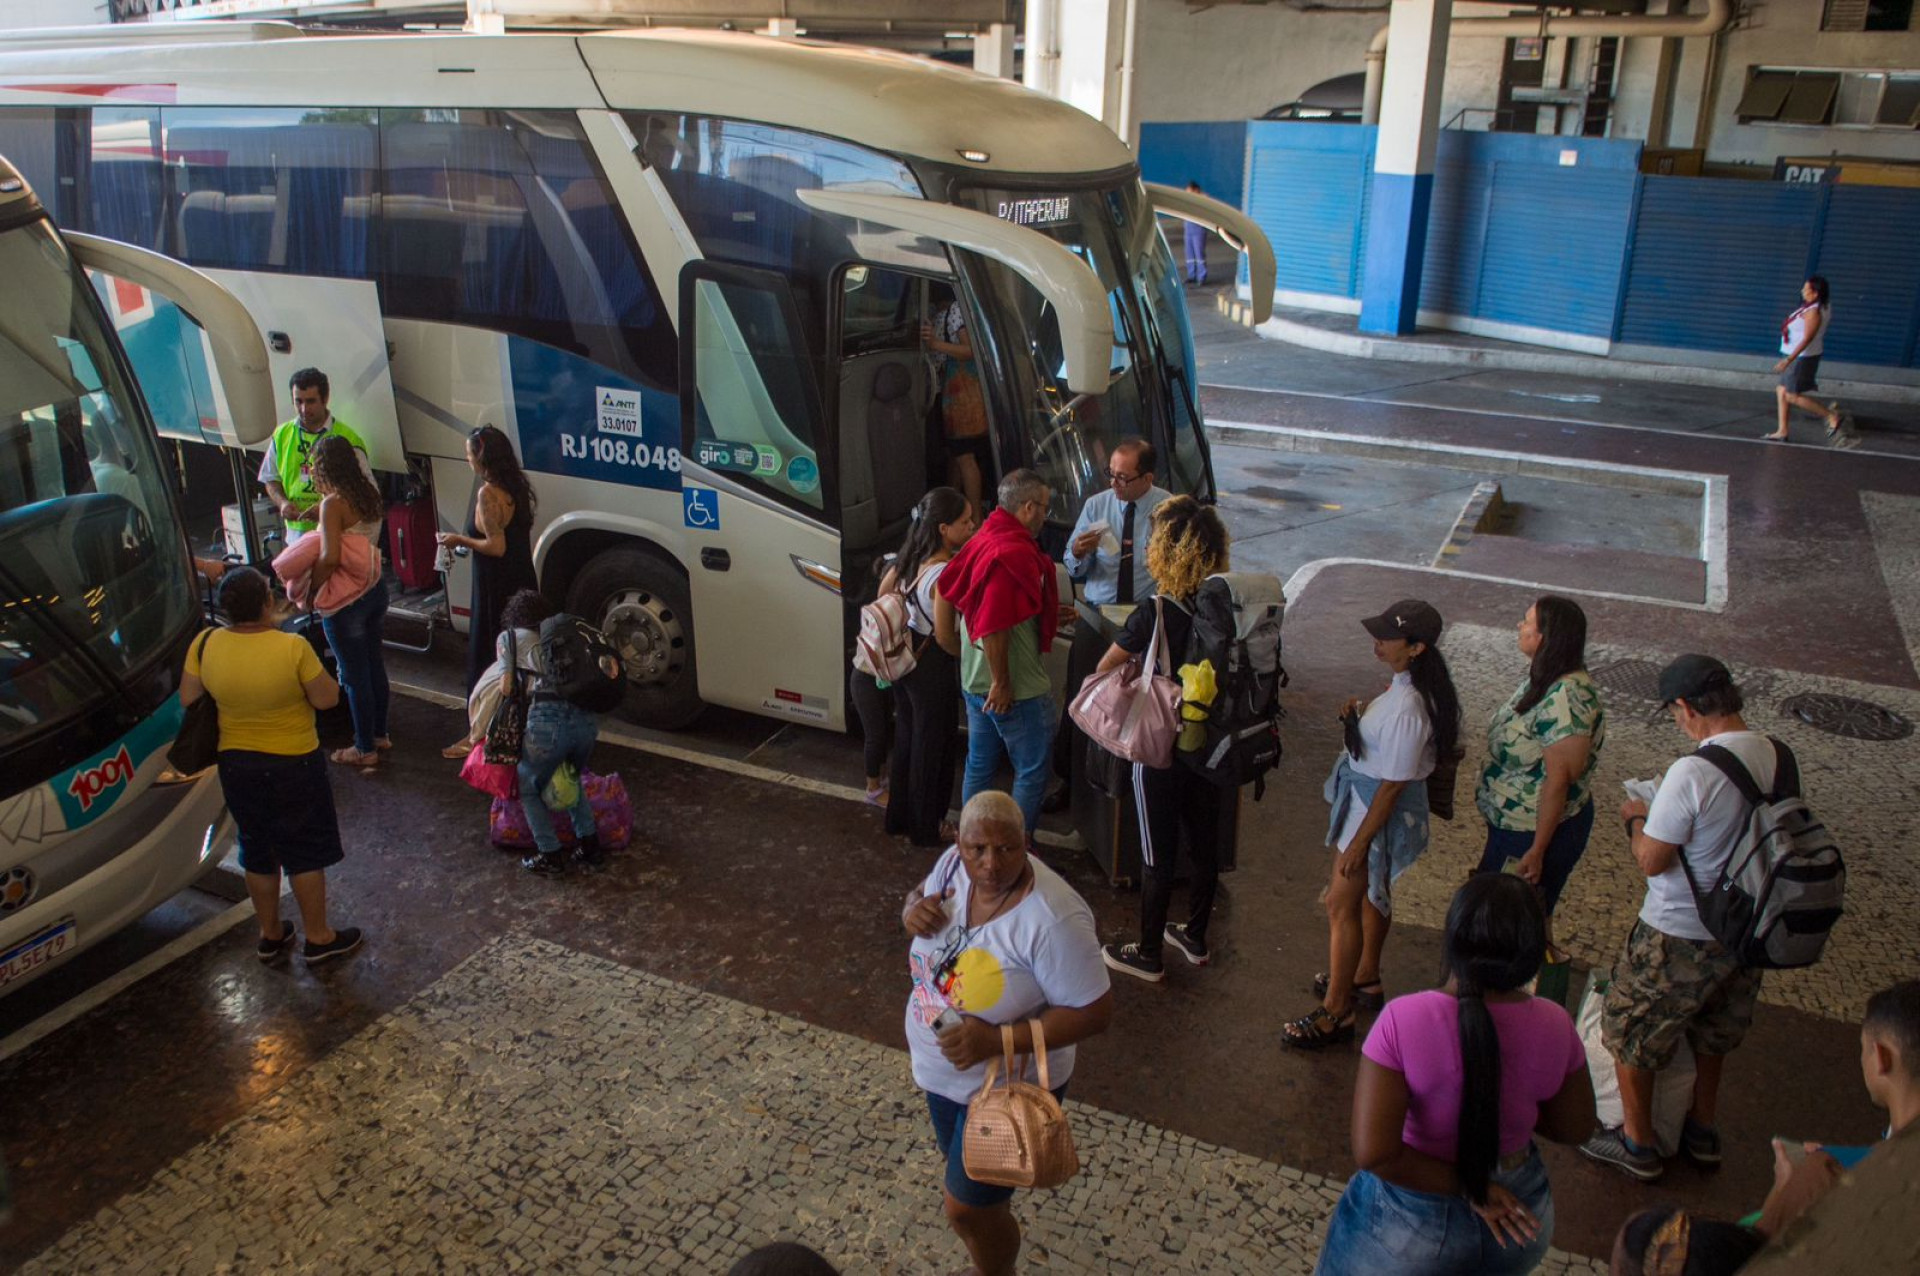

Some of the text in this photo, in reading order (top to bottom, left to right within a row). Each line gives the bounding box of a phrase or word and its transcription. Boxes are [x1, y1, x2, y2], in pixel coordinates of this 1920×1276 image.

[1784, 165, 1825, 183] CAT
[615, 400, 636, 409] ANTT
[602, 416, 637, 433] 33.0107
[699, 446, 731, 465] giro
[67, 743, 135, 813] 1001
